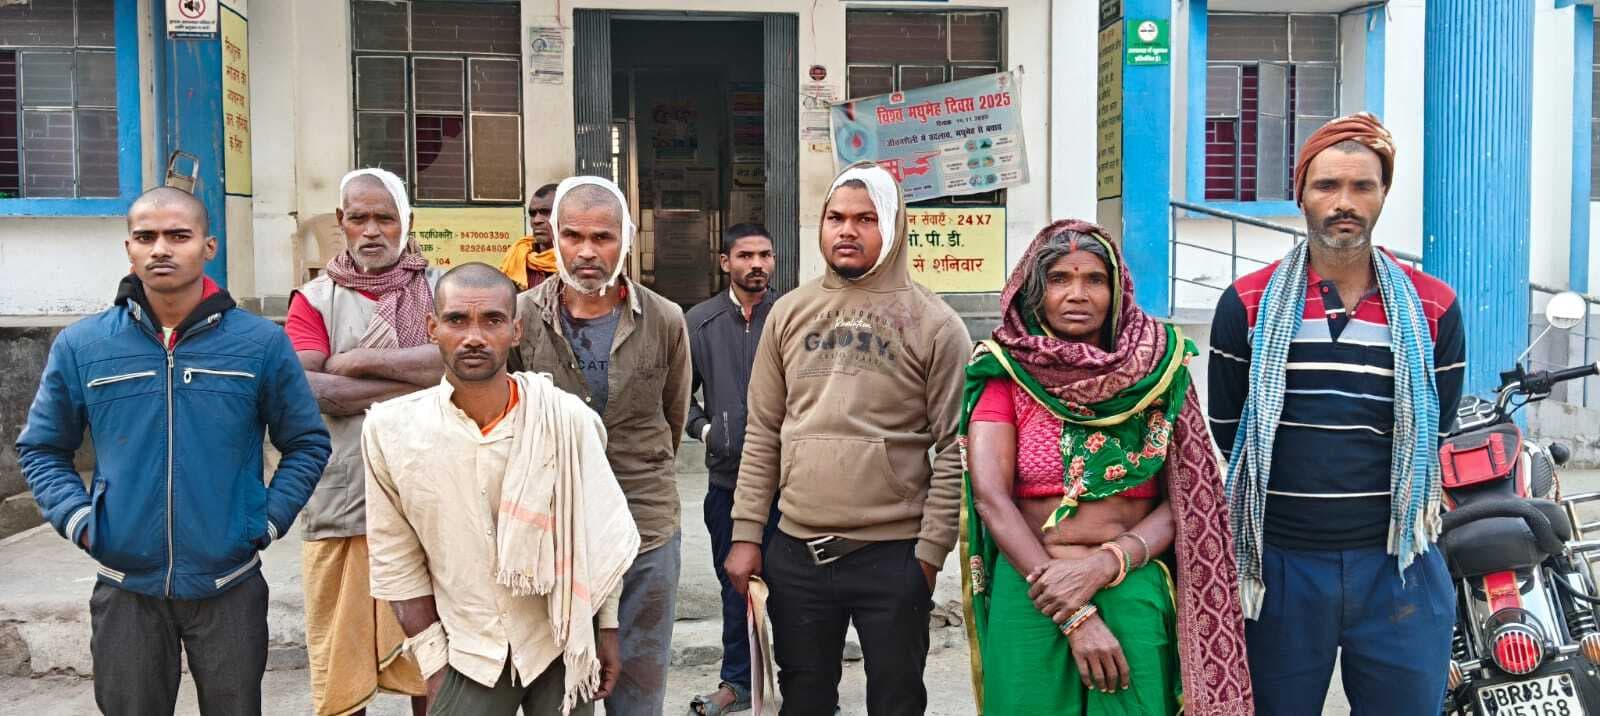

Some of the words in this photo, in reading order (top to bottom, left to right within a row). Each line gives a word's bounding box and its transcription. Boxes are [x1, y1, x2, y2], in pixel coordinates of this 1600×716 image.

[876, 107, 904, 125] विश्व
[908, 101, 942, 123] मधुमेह
[946, 96, 974, 114] दिवस
[979, 92, 1012, 109] 2025
[913, 254, 926, 272] से
[933, 254, 984, 273] शनिवार
[1495, 685, 1525, 707] BR
[1530, 678, 1559, 700] 34
